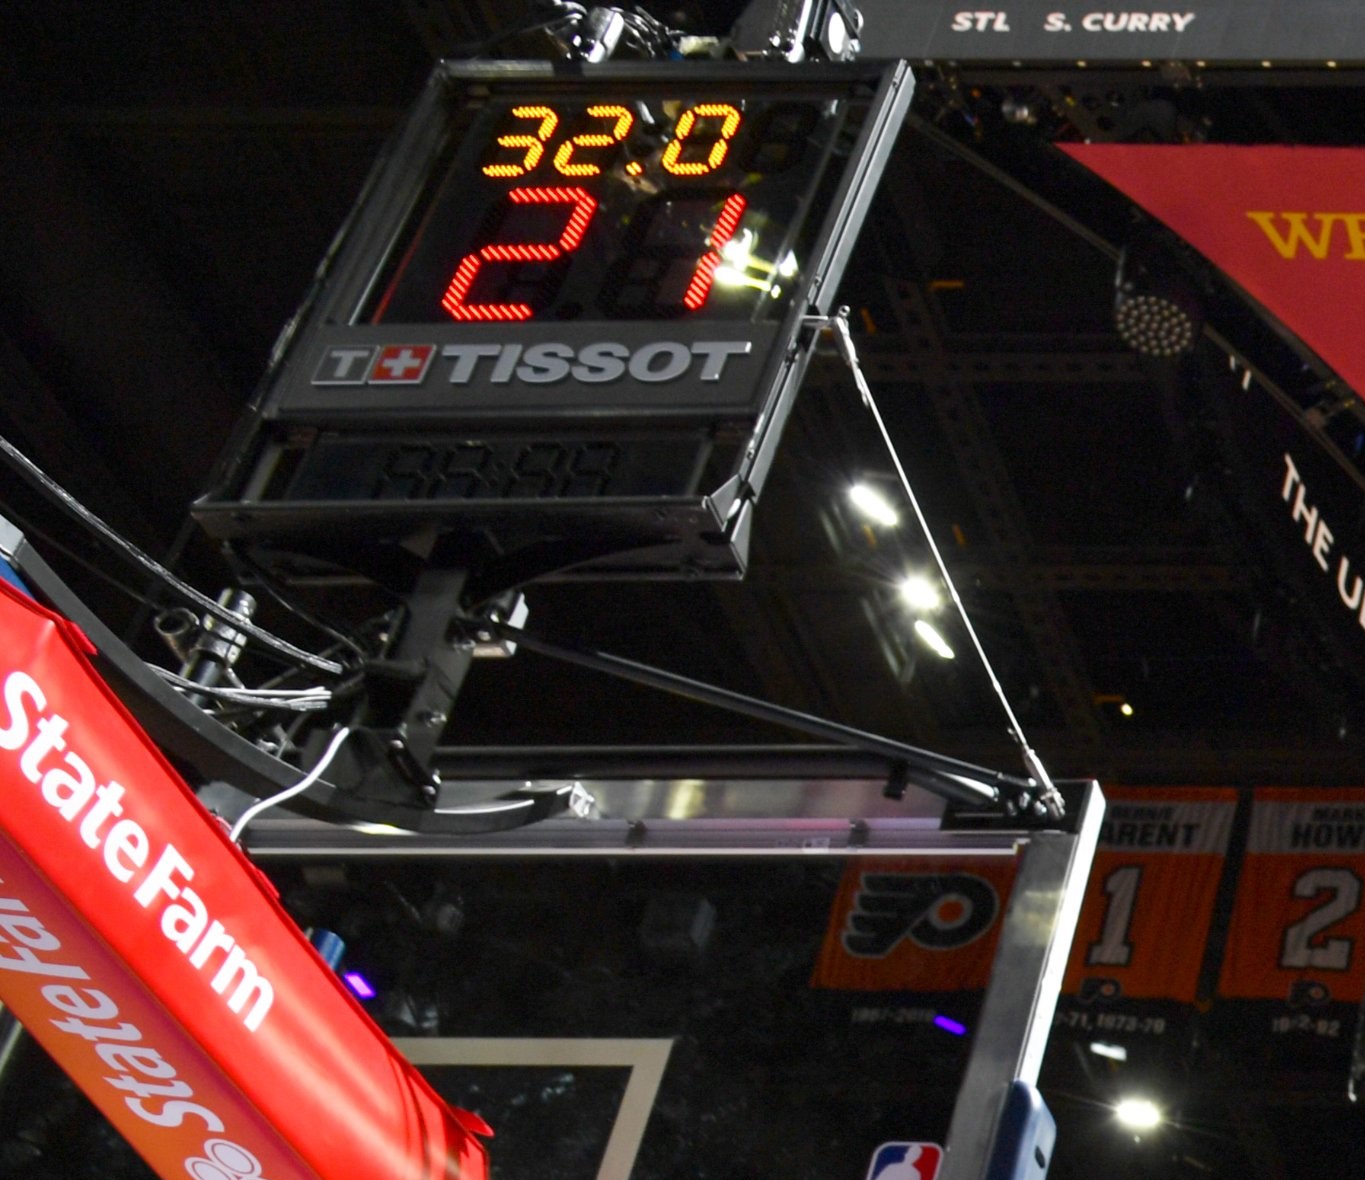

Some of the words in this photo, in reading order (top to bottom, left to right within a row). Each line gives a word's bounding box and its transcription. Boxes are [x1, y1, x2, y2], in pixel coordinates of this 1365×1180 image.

[952, 10, 1011, 33] STL
[1044, 10, 1073, 33] S.
[1082, 11, 1196, 34] CURRY
[481, 103, 742, 178] 32.0
[441, 341, 754, 384] TISSOT
[1279, 452, 1336, 573] THE
[1101, 821, 1202, 847] ARENT
[1278, 866, 1364, 971] 2
